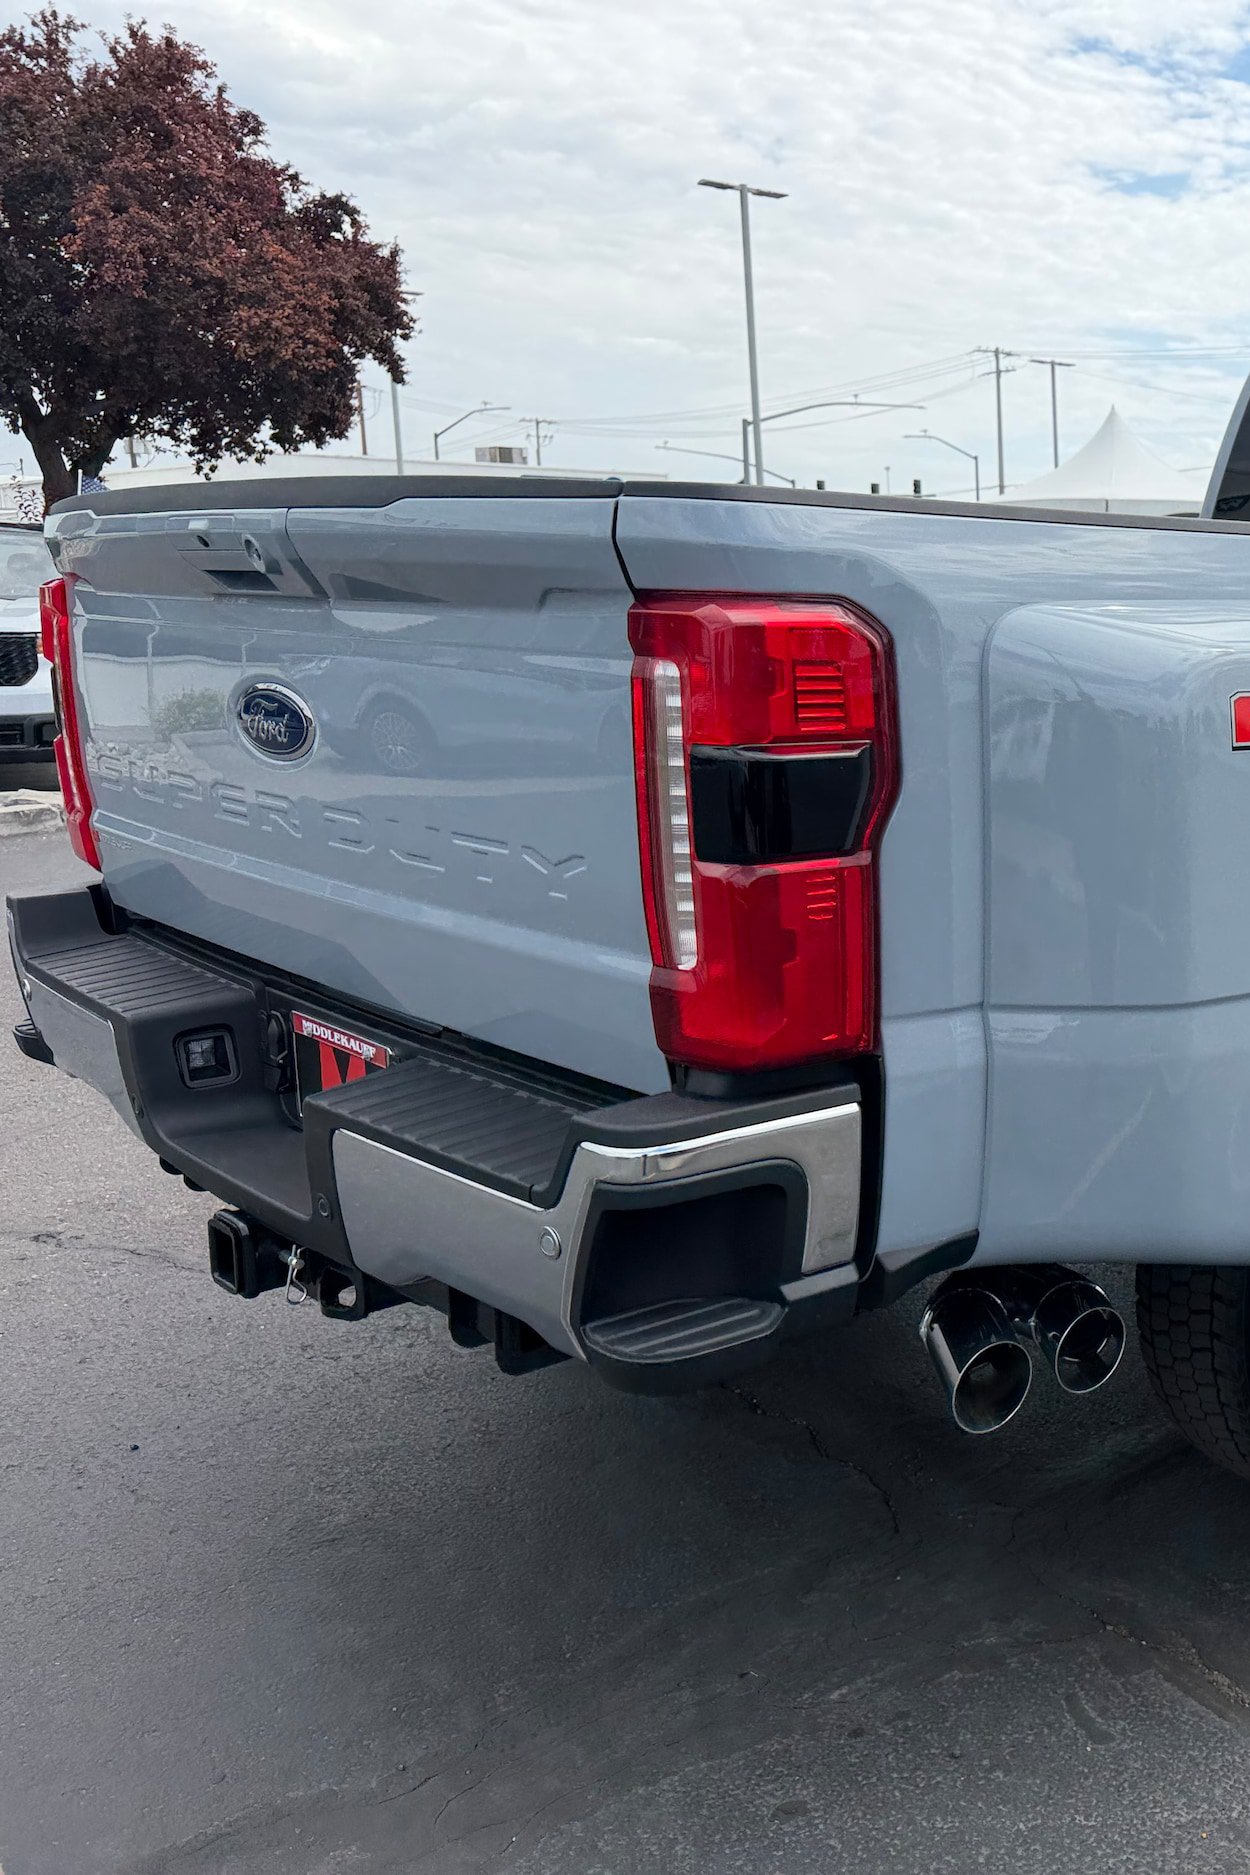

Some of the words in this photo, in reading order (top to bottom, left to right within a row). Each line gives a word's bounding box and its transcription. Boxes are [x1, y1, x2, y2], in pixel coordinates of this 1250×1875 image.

[248, 698, 290, 743] Ford
[97, 753, 303, 839] SUPER
[321, 804, 588, 900] DUTY
[302, 1019, 377, 1058] MIDDLEKAUFF
